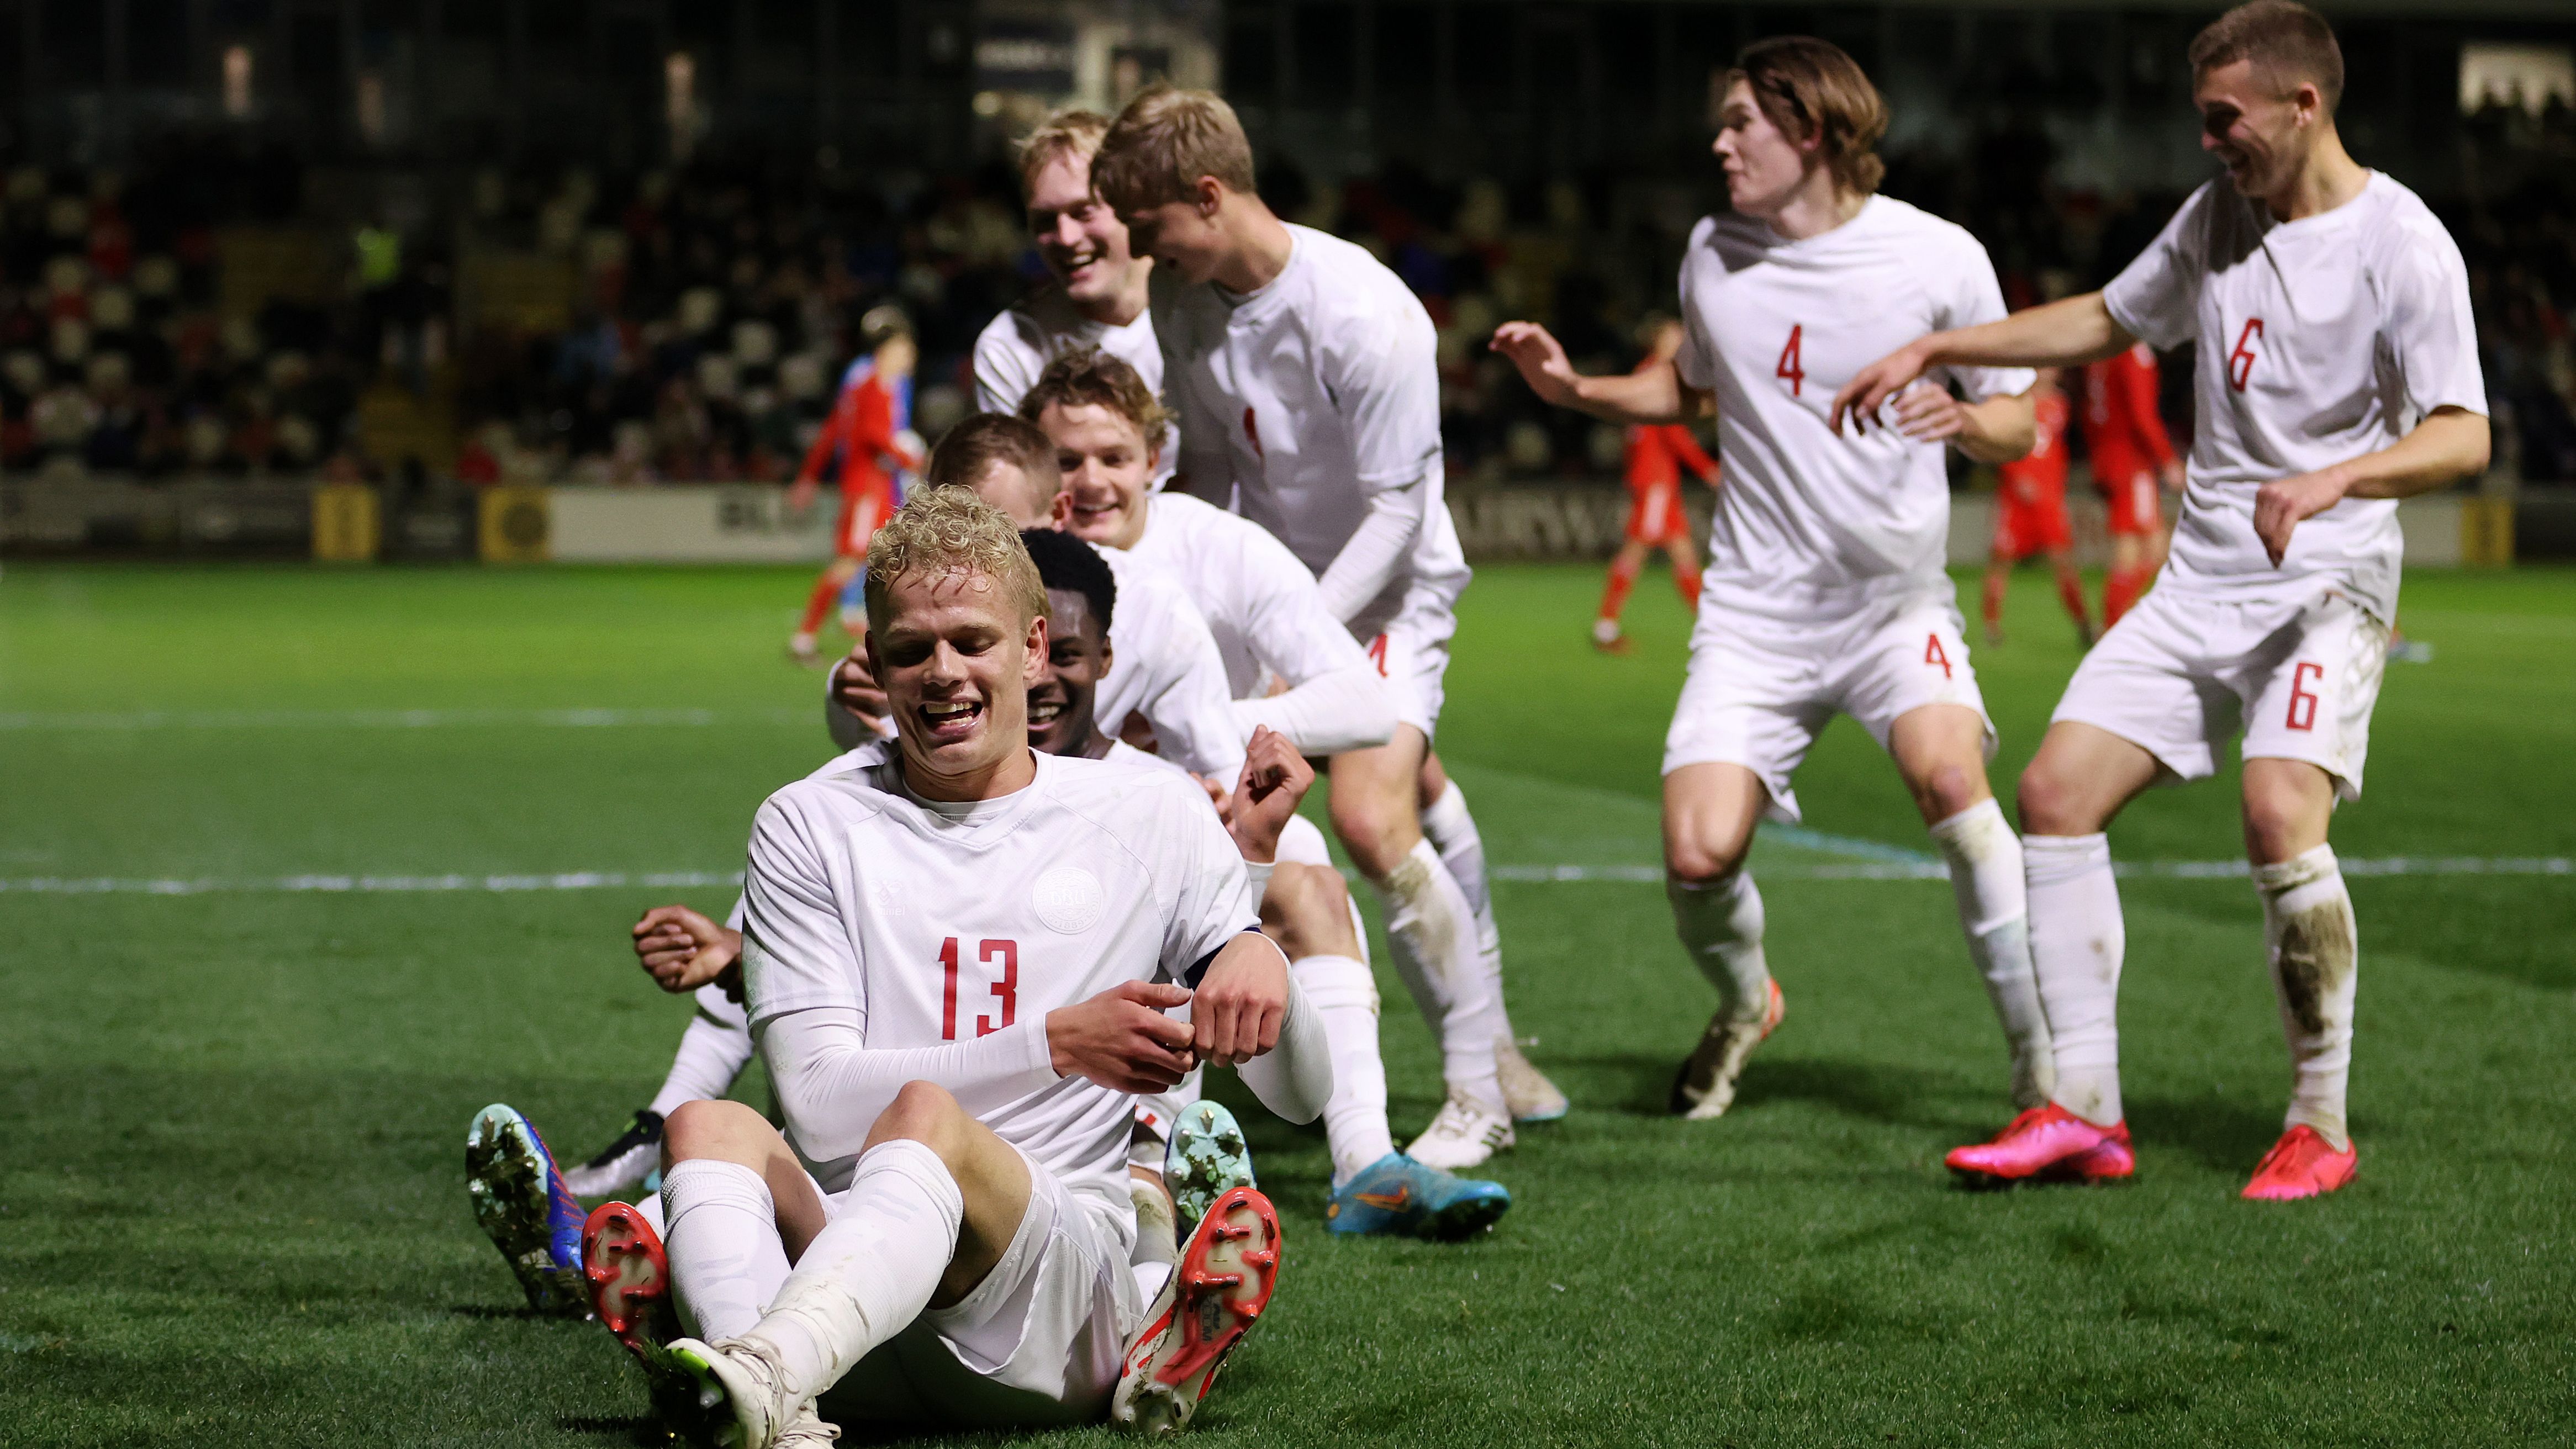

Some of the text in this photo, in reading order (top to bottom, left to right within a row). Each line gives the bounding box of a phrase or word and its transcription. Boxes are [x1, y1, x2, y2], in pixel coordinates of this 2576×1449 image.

[1776, 324, 1805, 398] 4
[2229, 318, 2263, 391] 6
[1925, 633, 1952, 680] 4
[2285, 662, 2324, 732] 6
[939, 937, 1018, 1040] 13
